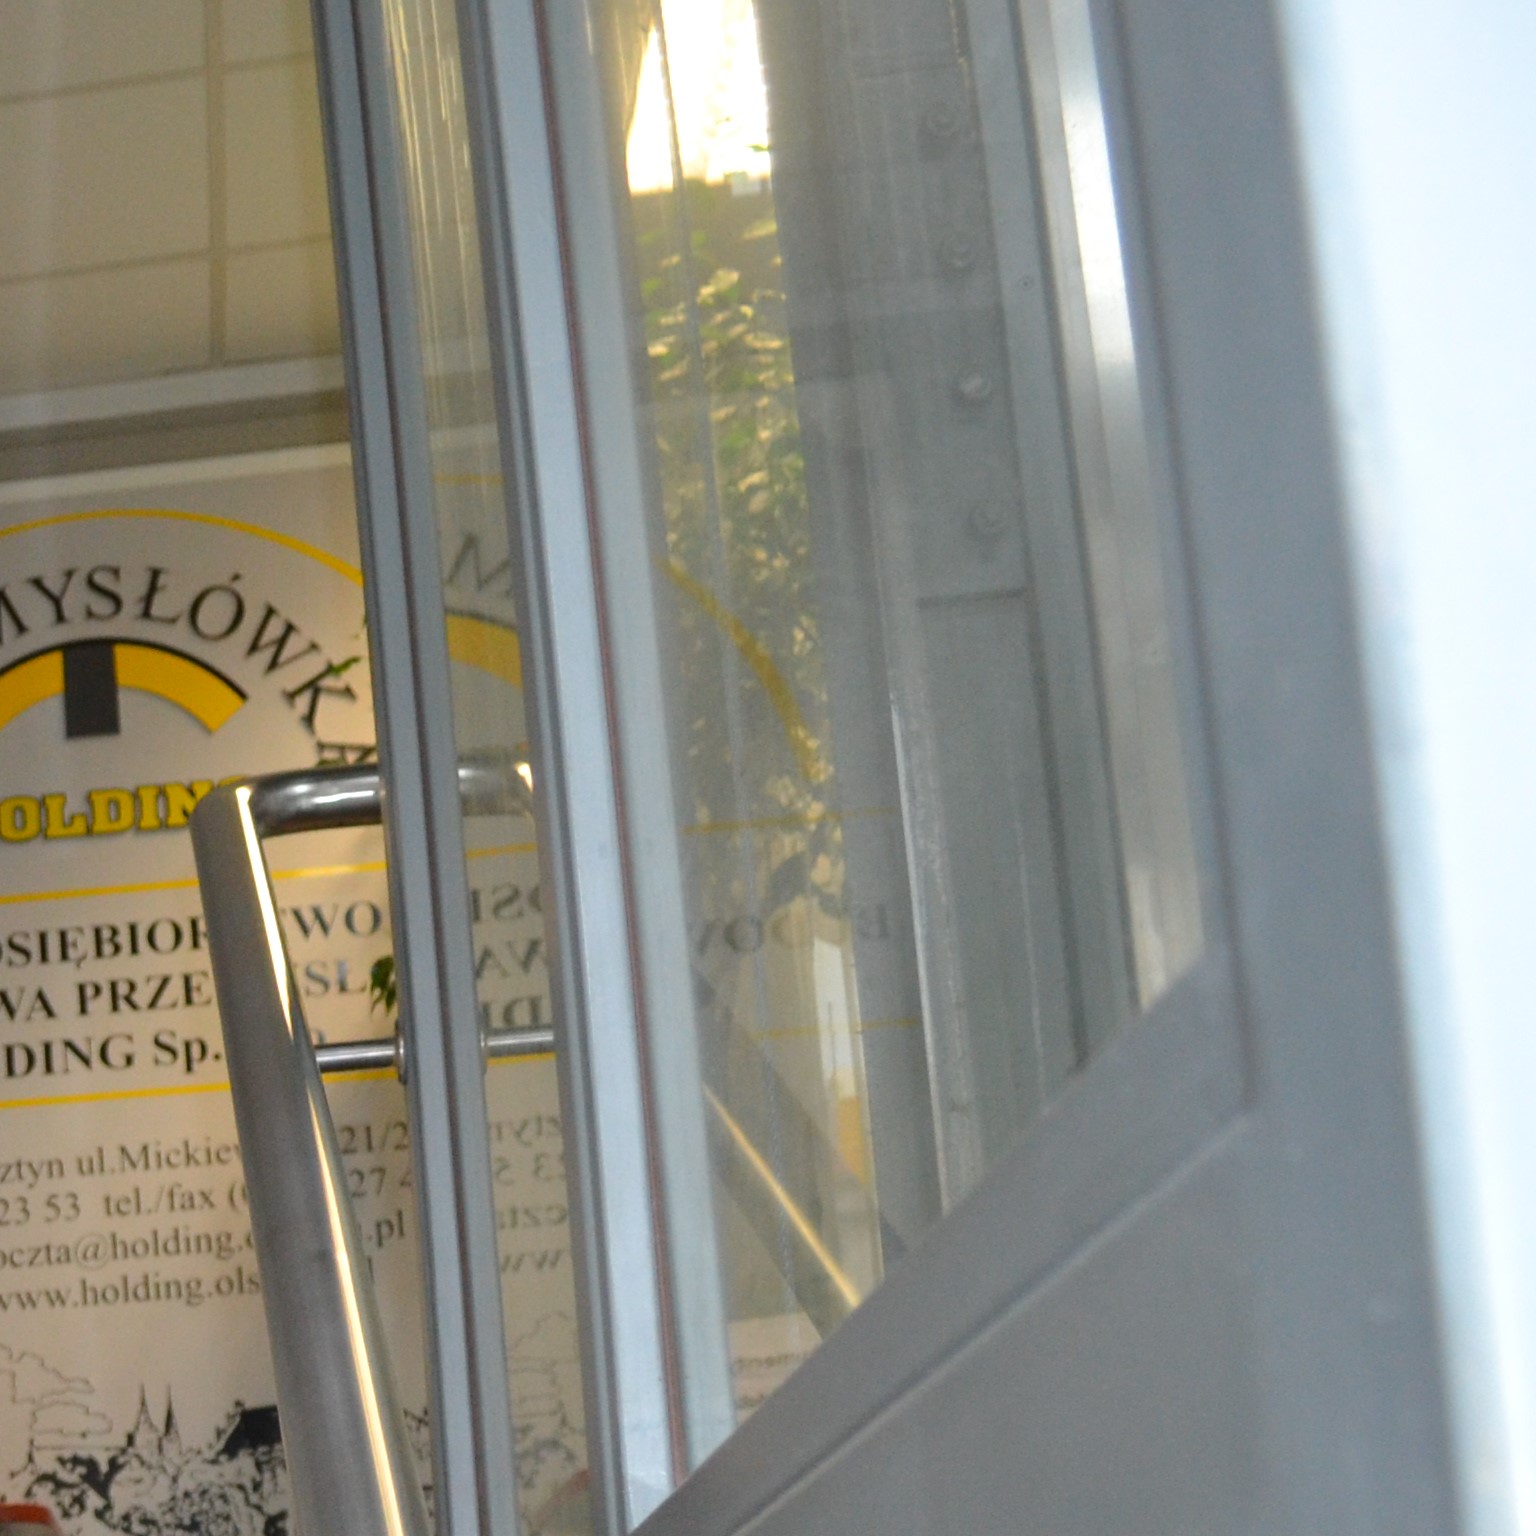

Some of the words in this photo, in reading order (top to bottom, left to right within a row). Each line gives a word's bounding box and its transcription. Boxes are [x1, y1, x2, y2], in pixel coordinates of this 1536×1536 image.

[153, 1029, 222, 1074] Sp.
[76, 1138, 242, 1178] ul.Mickie
[43, 1190, 82, 1222] 53
[103, 1180, 217, 1217] tel./fax
